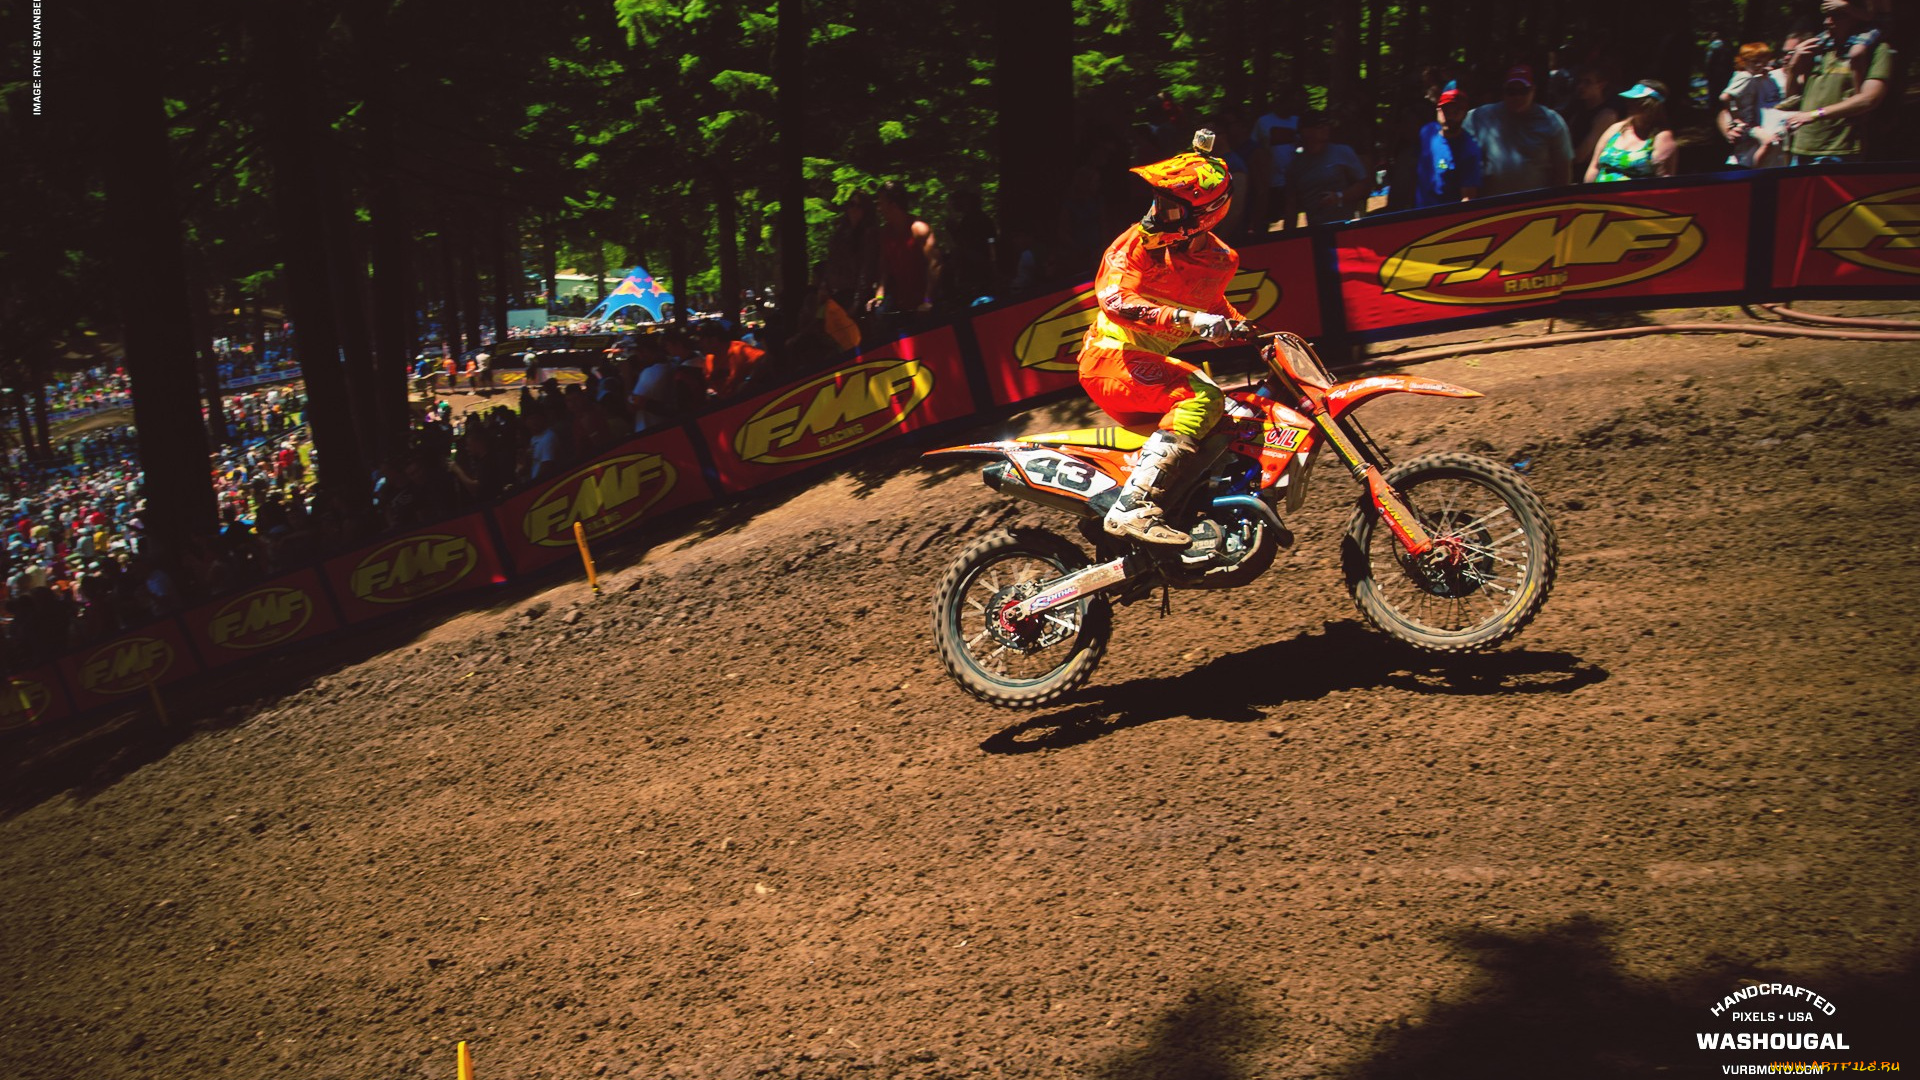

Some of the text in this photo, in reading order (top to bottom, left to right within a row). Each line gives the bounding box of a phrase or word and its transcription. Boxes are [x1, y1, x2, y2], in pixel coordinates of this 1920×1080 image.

[1383, 211, 1694, 294] FMF
[741, 358, 921, 461] FMF
[817, 423, 865, 448] RACING
[1265, 426, 1299, 449] OIL
[528, 453, 664, 545] FMF
[1025, 456, 1097, 492] 43
[353, 536, 468, 599] FMF
[210, 588, 305, 646] FMF
[80, 638, 166, 691] FMF
